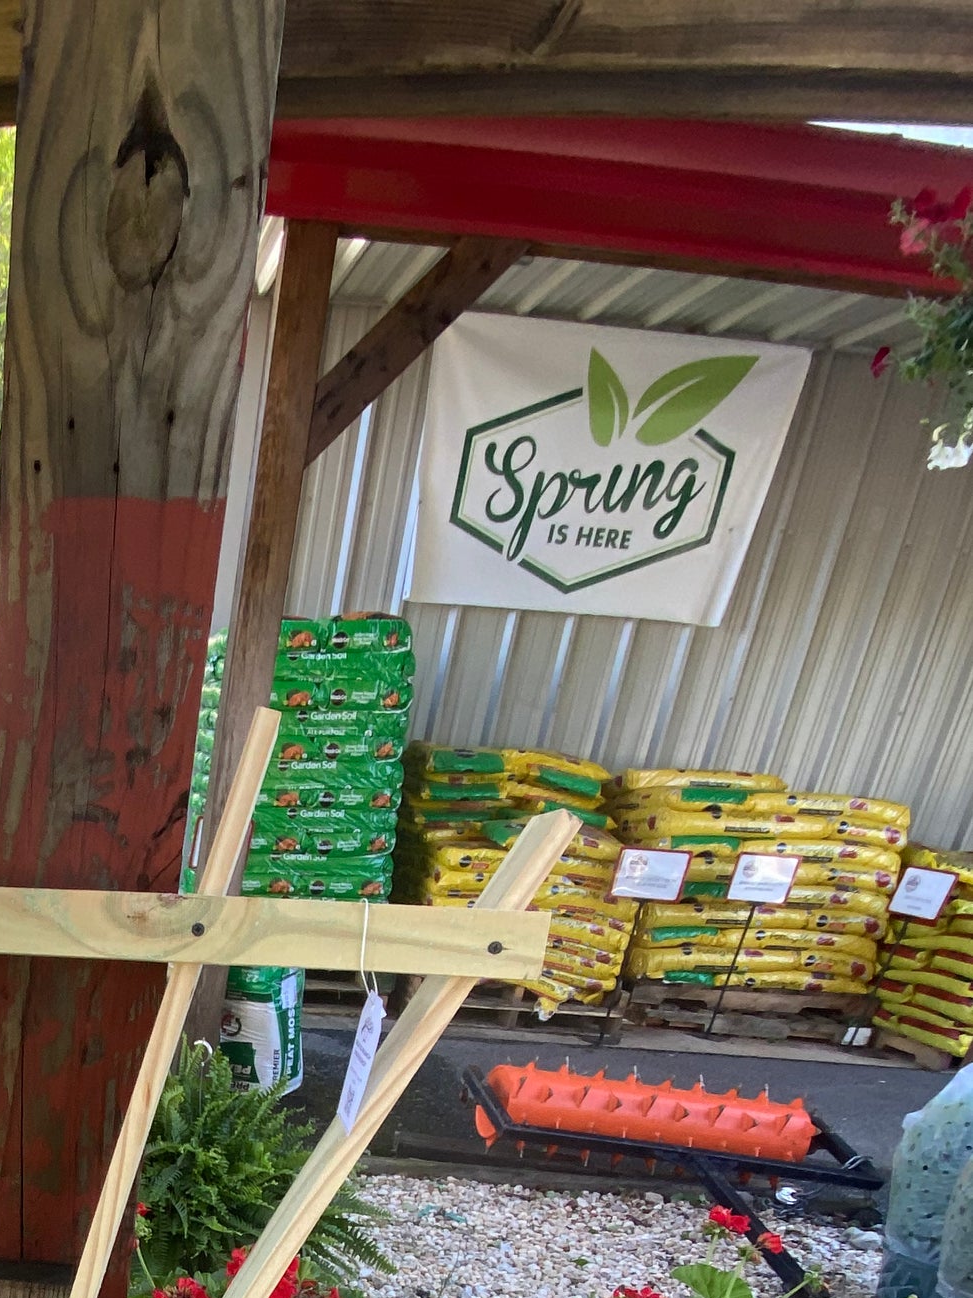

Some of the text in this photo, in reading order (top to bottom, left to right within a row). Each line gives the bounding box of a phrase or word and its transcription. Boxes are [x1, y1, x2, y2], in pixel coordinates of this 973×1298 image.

[485, 435, 707, 561] Spring
[547, 524, 633, 549] IS HERE
[310, 711, 357, 720] Garden Soil
[291, 761, 337, 770] Garden Soil
[300, 809, 345, 818] Garden Soil
[283, 853, 312, 861] Garden
[288, 1008, 296, 1039] MOS
[272, 1049, 280, 1081] REMIER
